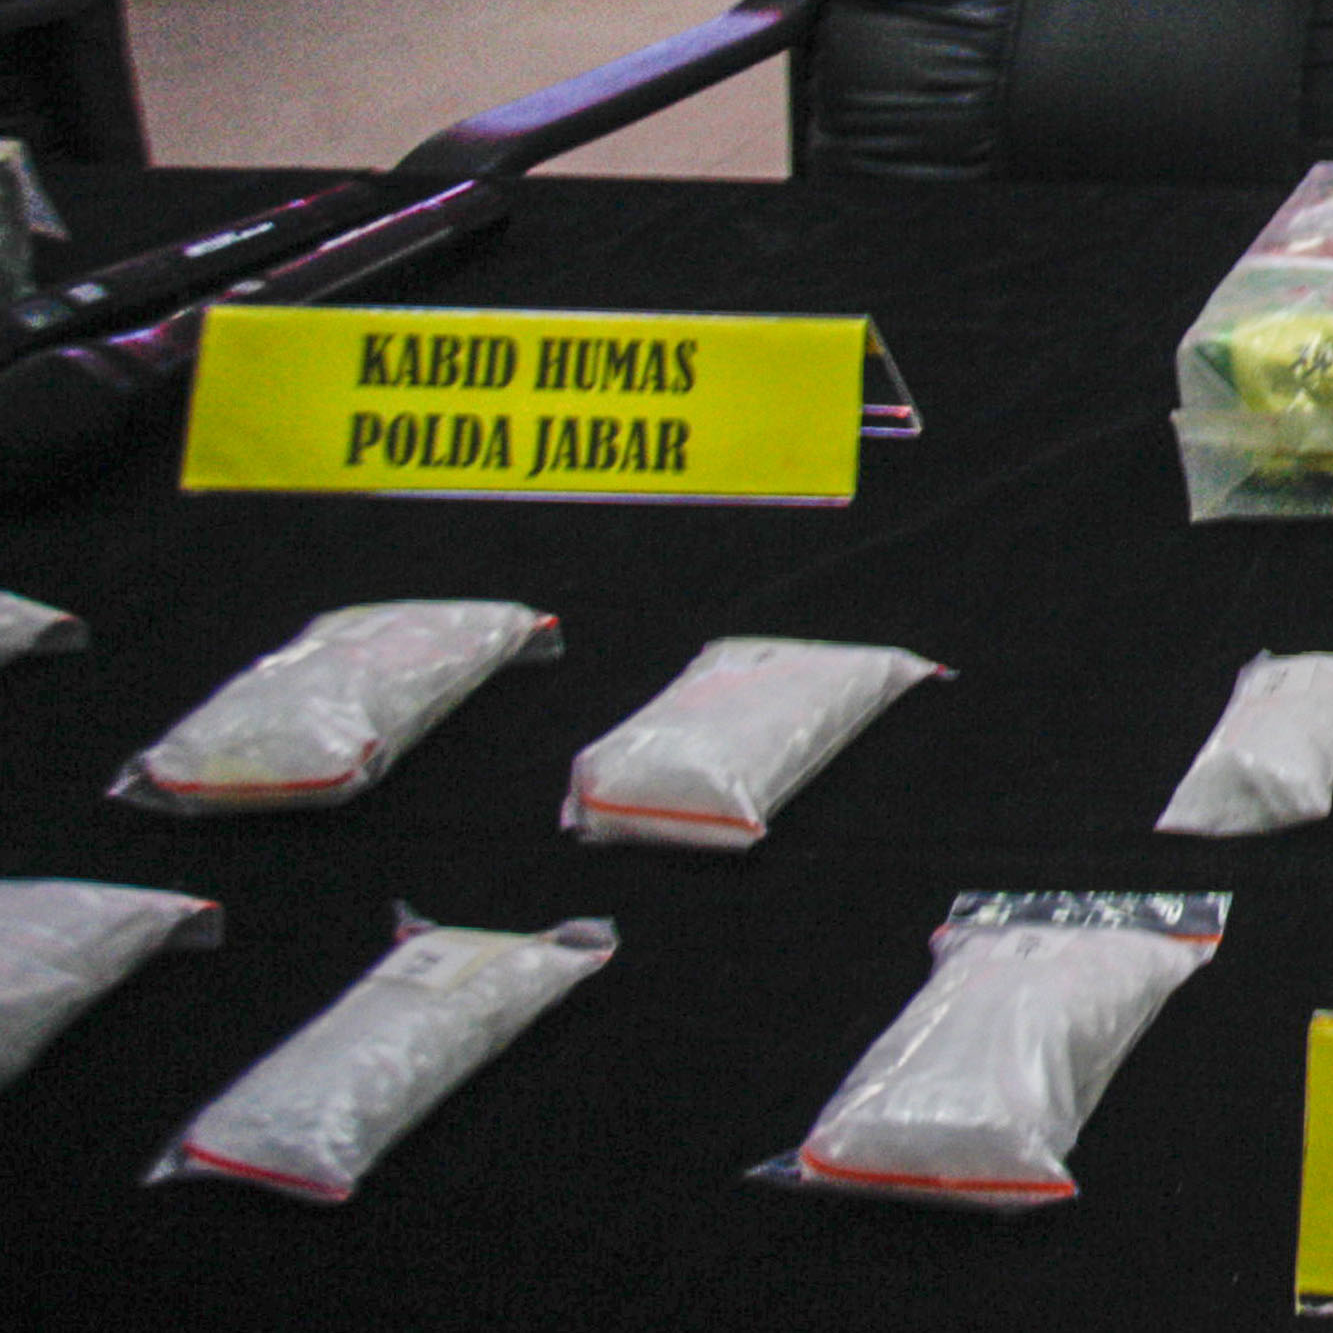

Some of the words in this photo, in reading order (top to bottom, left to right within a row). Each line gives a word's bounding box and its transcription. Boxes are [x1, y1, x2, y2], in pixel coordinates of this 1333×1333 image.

[357, 332, 518, 391] KABID
[533, 336, 699, 396] HUMAS
[345, 411, 514, 470] POLDA
[525, 416, 693, 481] JABAR
